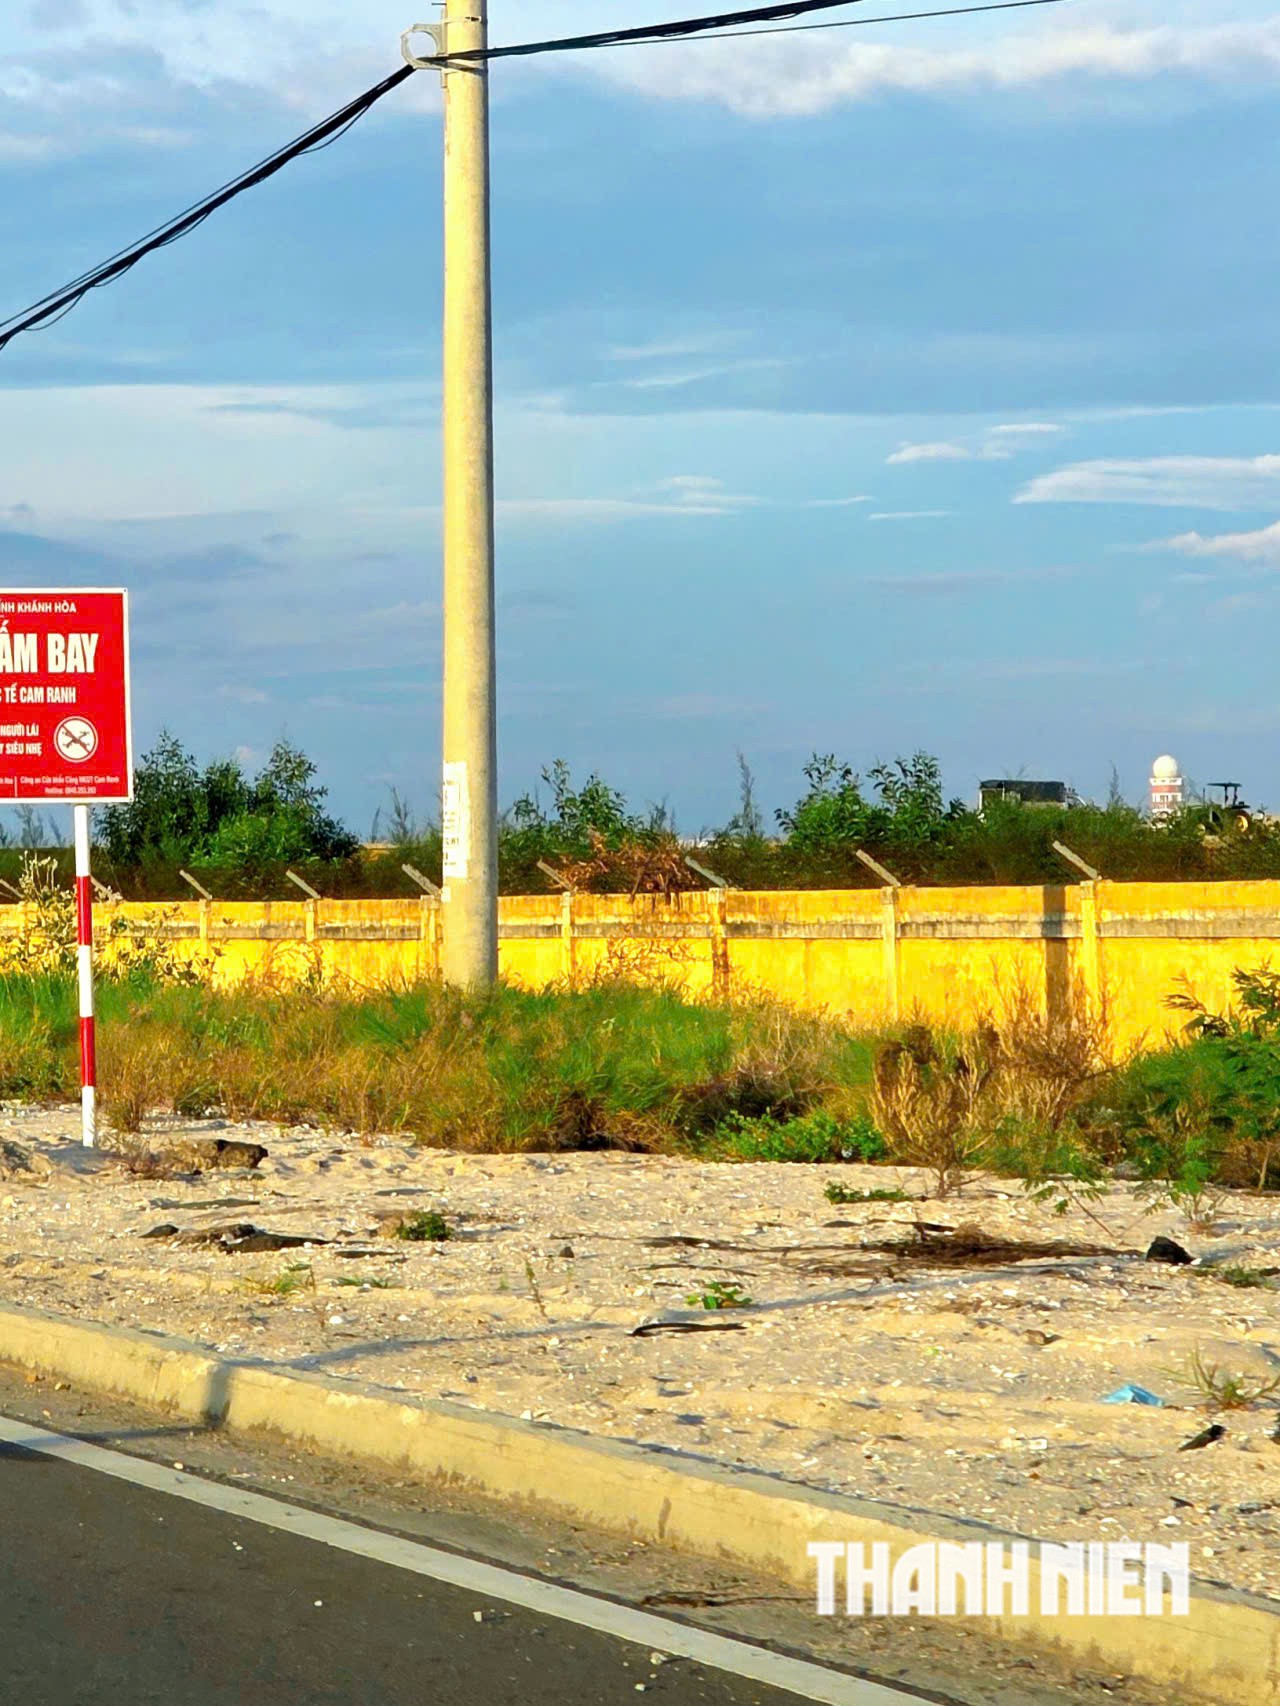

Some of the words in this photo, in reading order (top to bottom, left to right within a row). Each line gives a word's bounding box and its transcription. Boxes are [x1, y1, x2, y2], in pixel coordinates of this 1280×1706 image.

[17, 599, 53, 613] KHÁNH
[54, 599, 77, 613] HÒA
[48, 632, 99, 673] BAY
[4, 682, 18, 703] TẾ
[20, 686, 44, 703] CAM
[47, 686, 77, 703] RANH
[26, 723, 39, 737] LÁI
